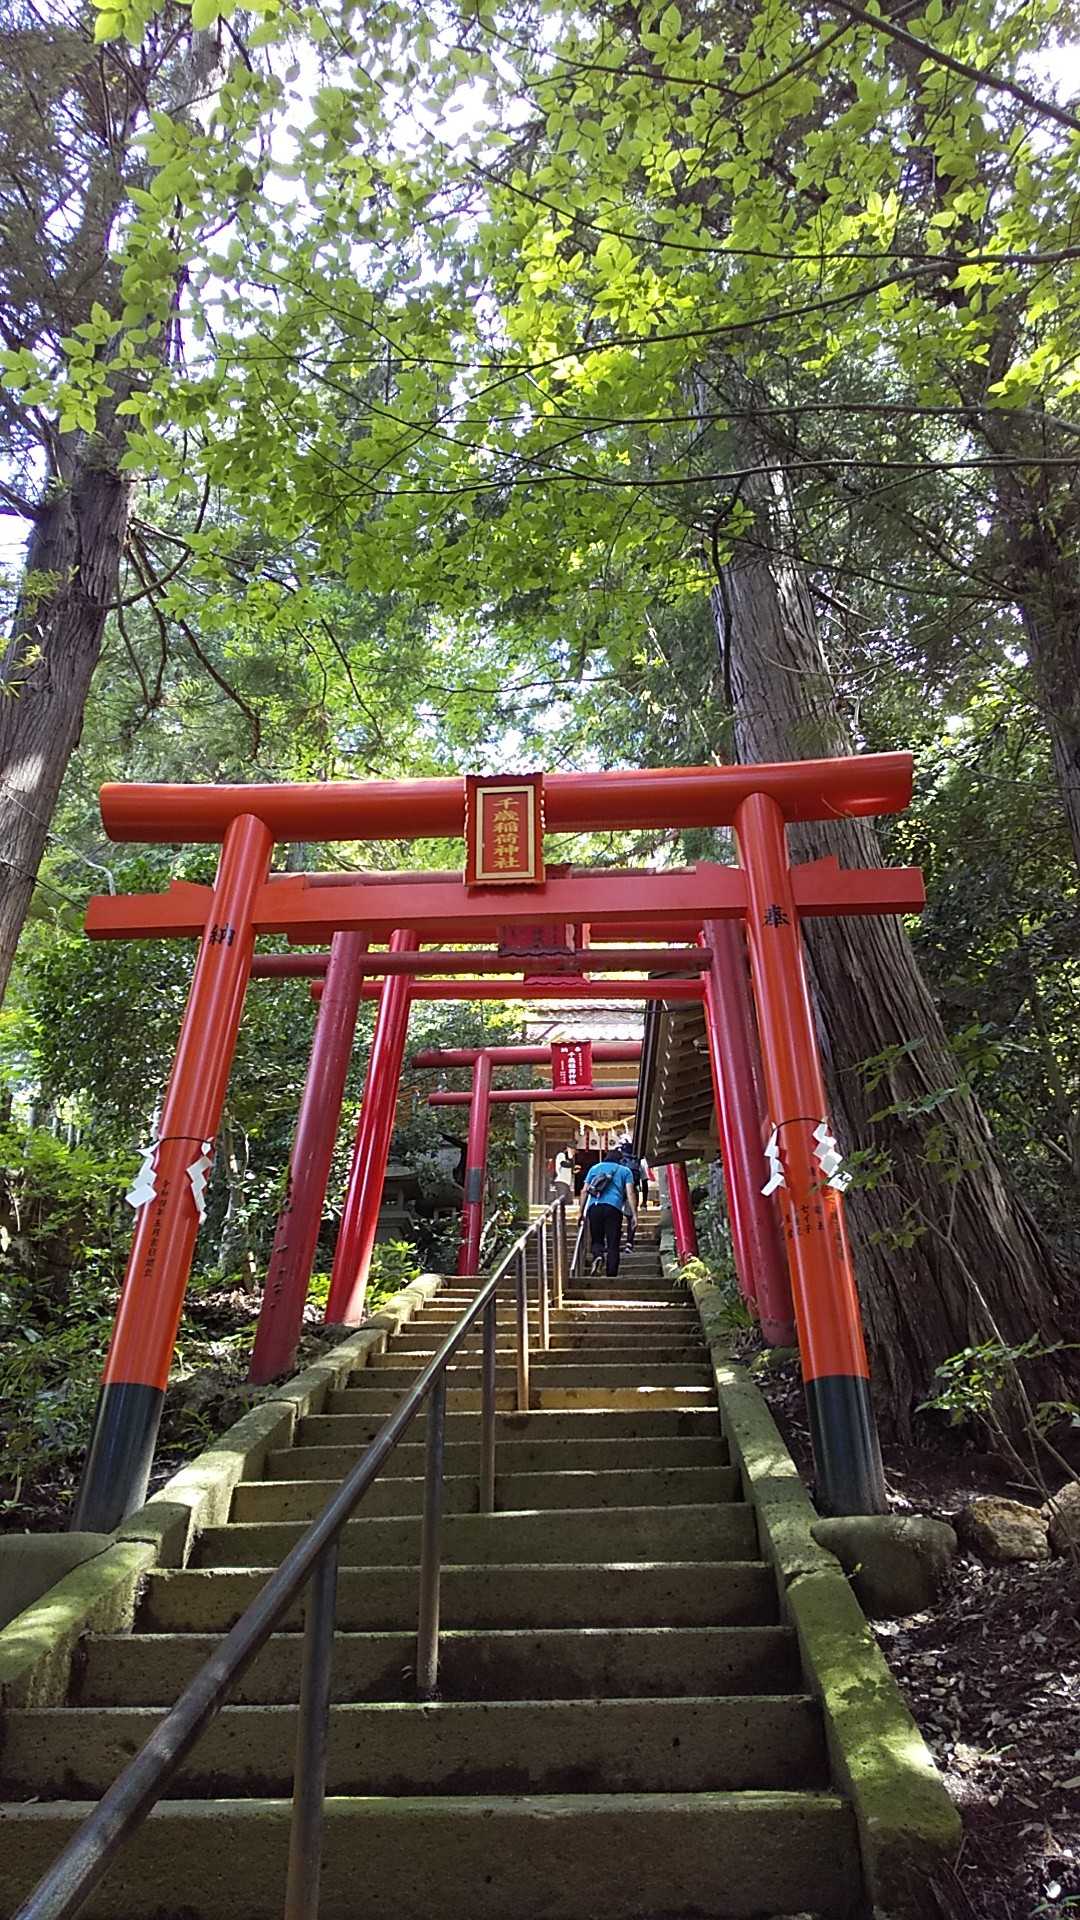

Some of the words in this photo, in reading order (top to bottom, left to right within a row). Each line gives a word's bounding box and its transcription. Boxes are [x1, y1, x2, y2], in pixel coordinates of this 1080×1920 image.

[492, 797, 521, 869] 千歳稲荷神社
[763, 904, 792, 928] 奉
[208, 922, 236, 947] 納
